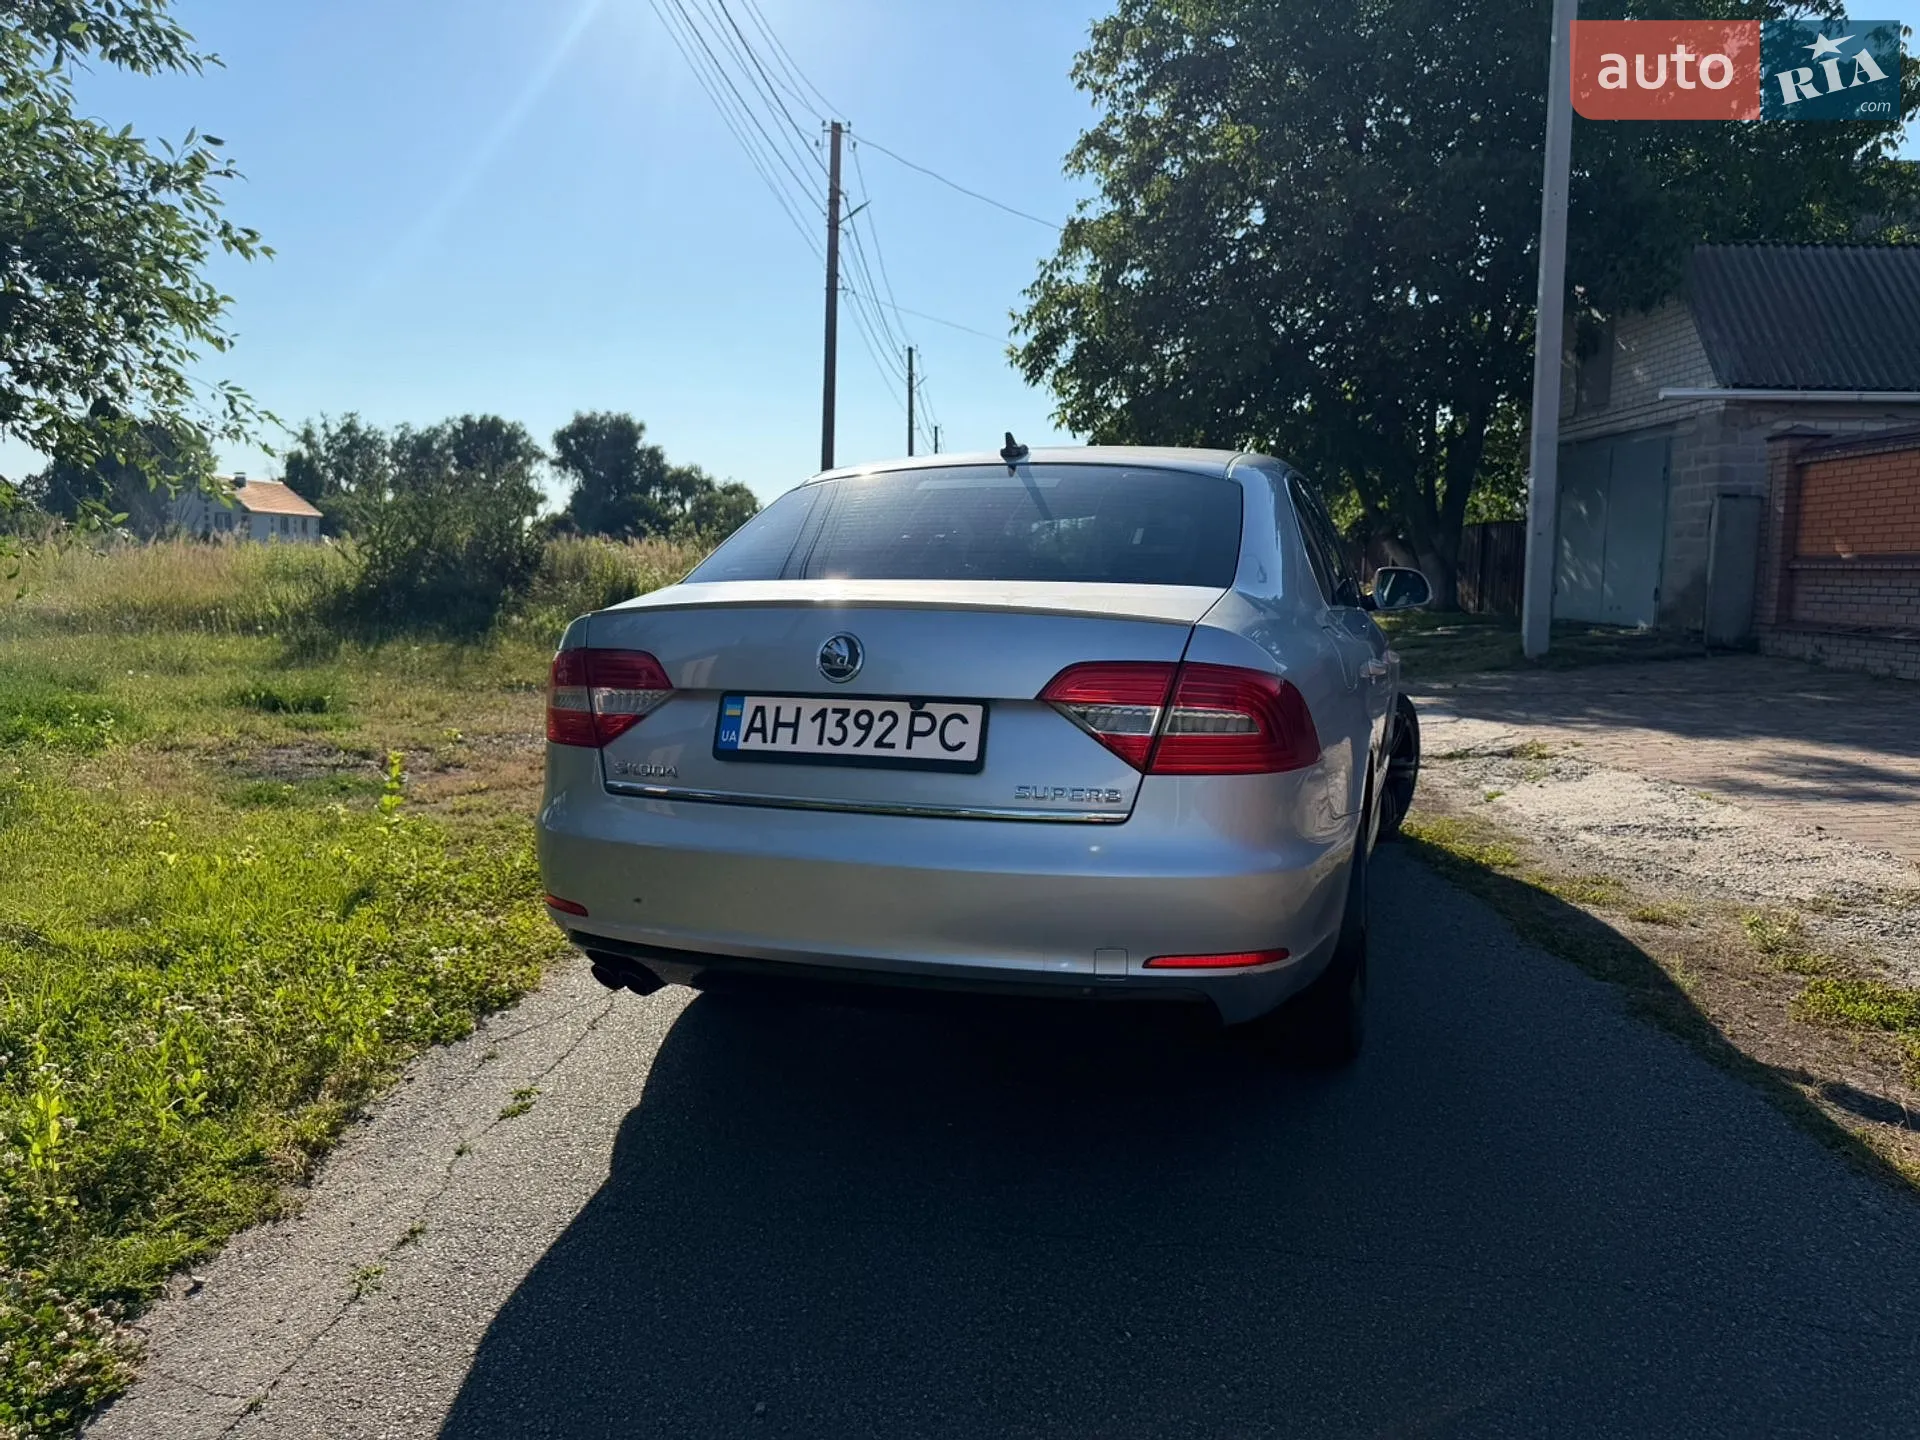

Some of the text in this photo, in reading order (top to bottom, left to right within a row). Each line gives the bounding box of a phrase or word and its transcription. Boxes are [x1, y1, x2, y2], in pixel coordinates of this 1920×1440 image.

[721, 730, 738, 743] UA
[743, 705, 969, 752] AH 1392 PC
[1014, 785, 1122, 803] SUPERB
